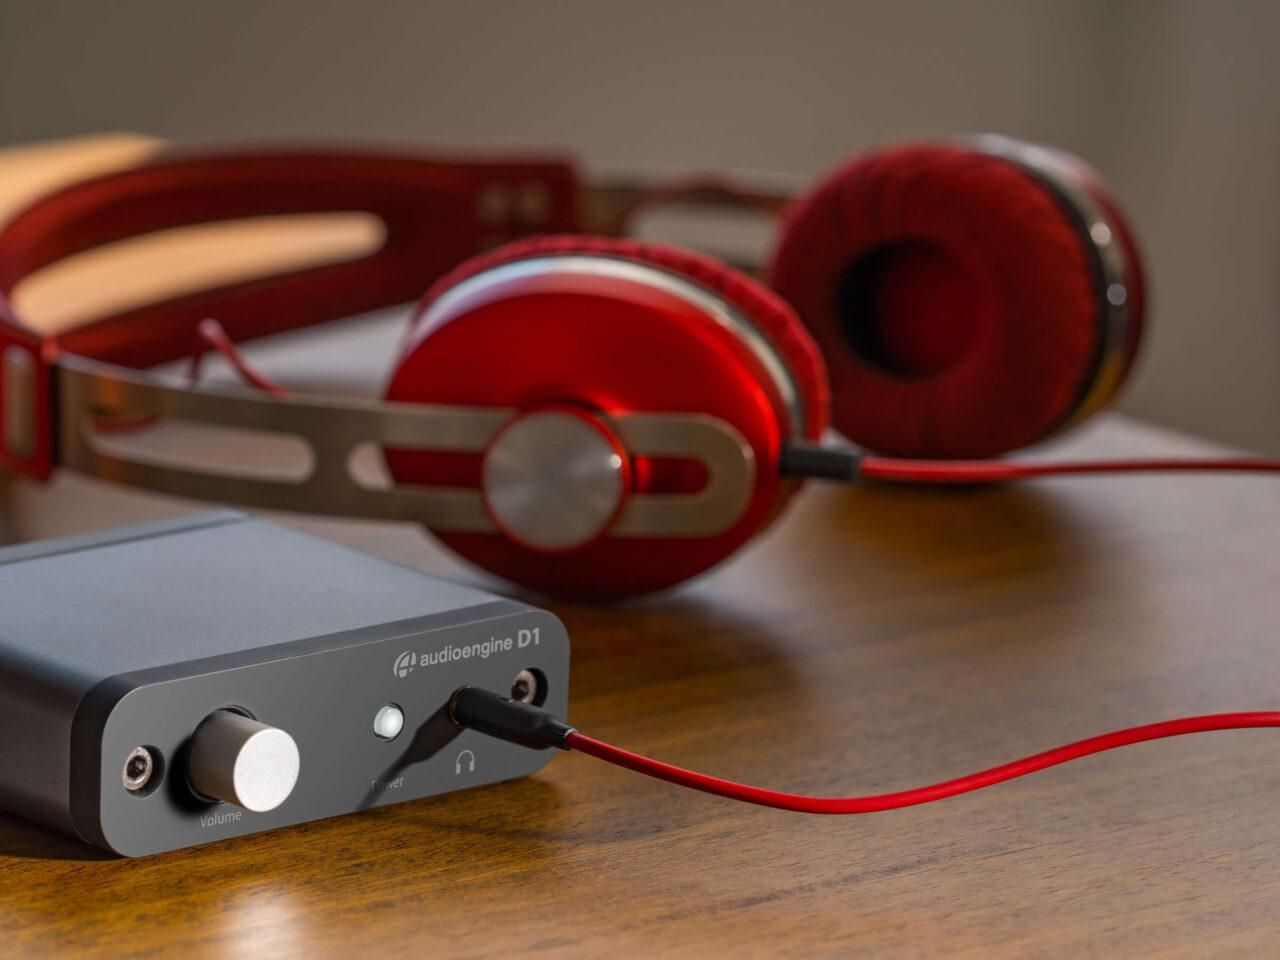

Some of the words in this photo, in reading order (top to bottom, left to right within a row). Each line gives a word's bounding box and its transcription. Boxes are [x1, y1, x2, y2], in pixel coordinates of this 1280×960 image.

[420, 636, 513, 667] audioengine
[517, 627, 540, 648] D1
[371, 776, 405, 792] Pwer
[200, 809, 242, 828] Volume
